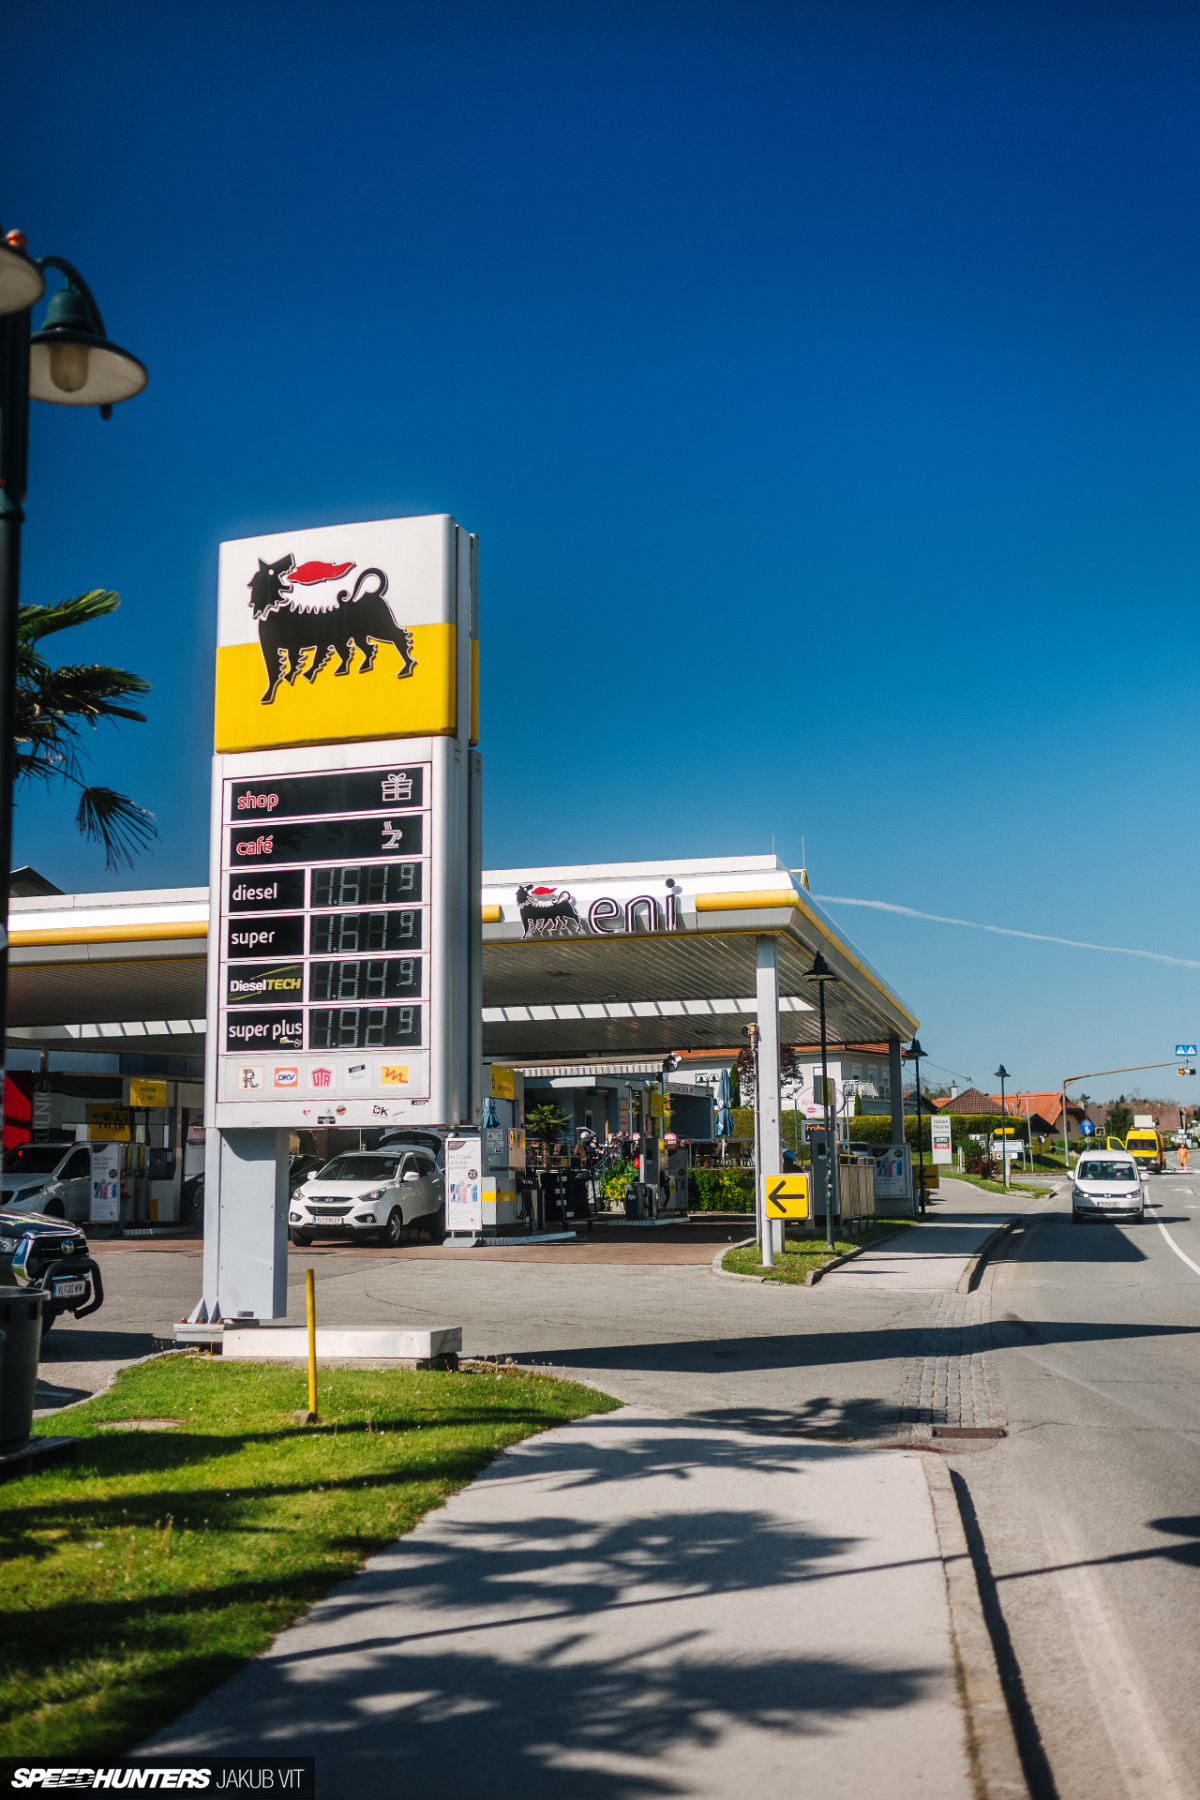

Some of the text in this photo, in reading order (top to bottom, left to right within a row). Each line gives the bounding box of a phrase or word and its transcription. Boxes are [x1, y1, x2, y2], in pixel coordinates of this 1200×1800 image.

[237, 791, 279, 811] shop
[236, 834, 273, 855] café
[232, 883, 278, 901] diesel
[588, 878, 677, 934] eni
[231, 930, 276, 948] super
[230, 978, 302, 992] DieselTECH
[228, 1022, 270, 1041] super
[272, 1019, 303, 1040] plus
[312, 1068, 331, 1087] UTA
